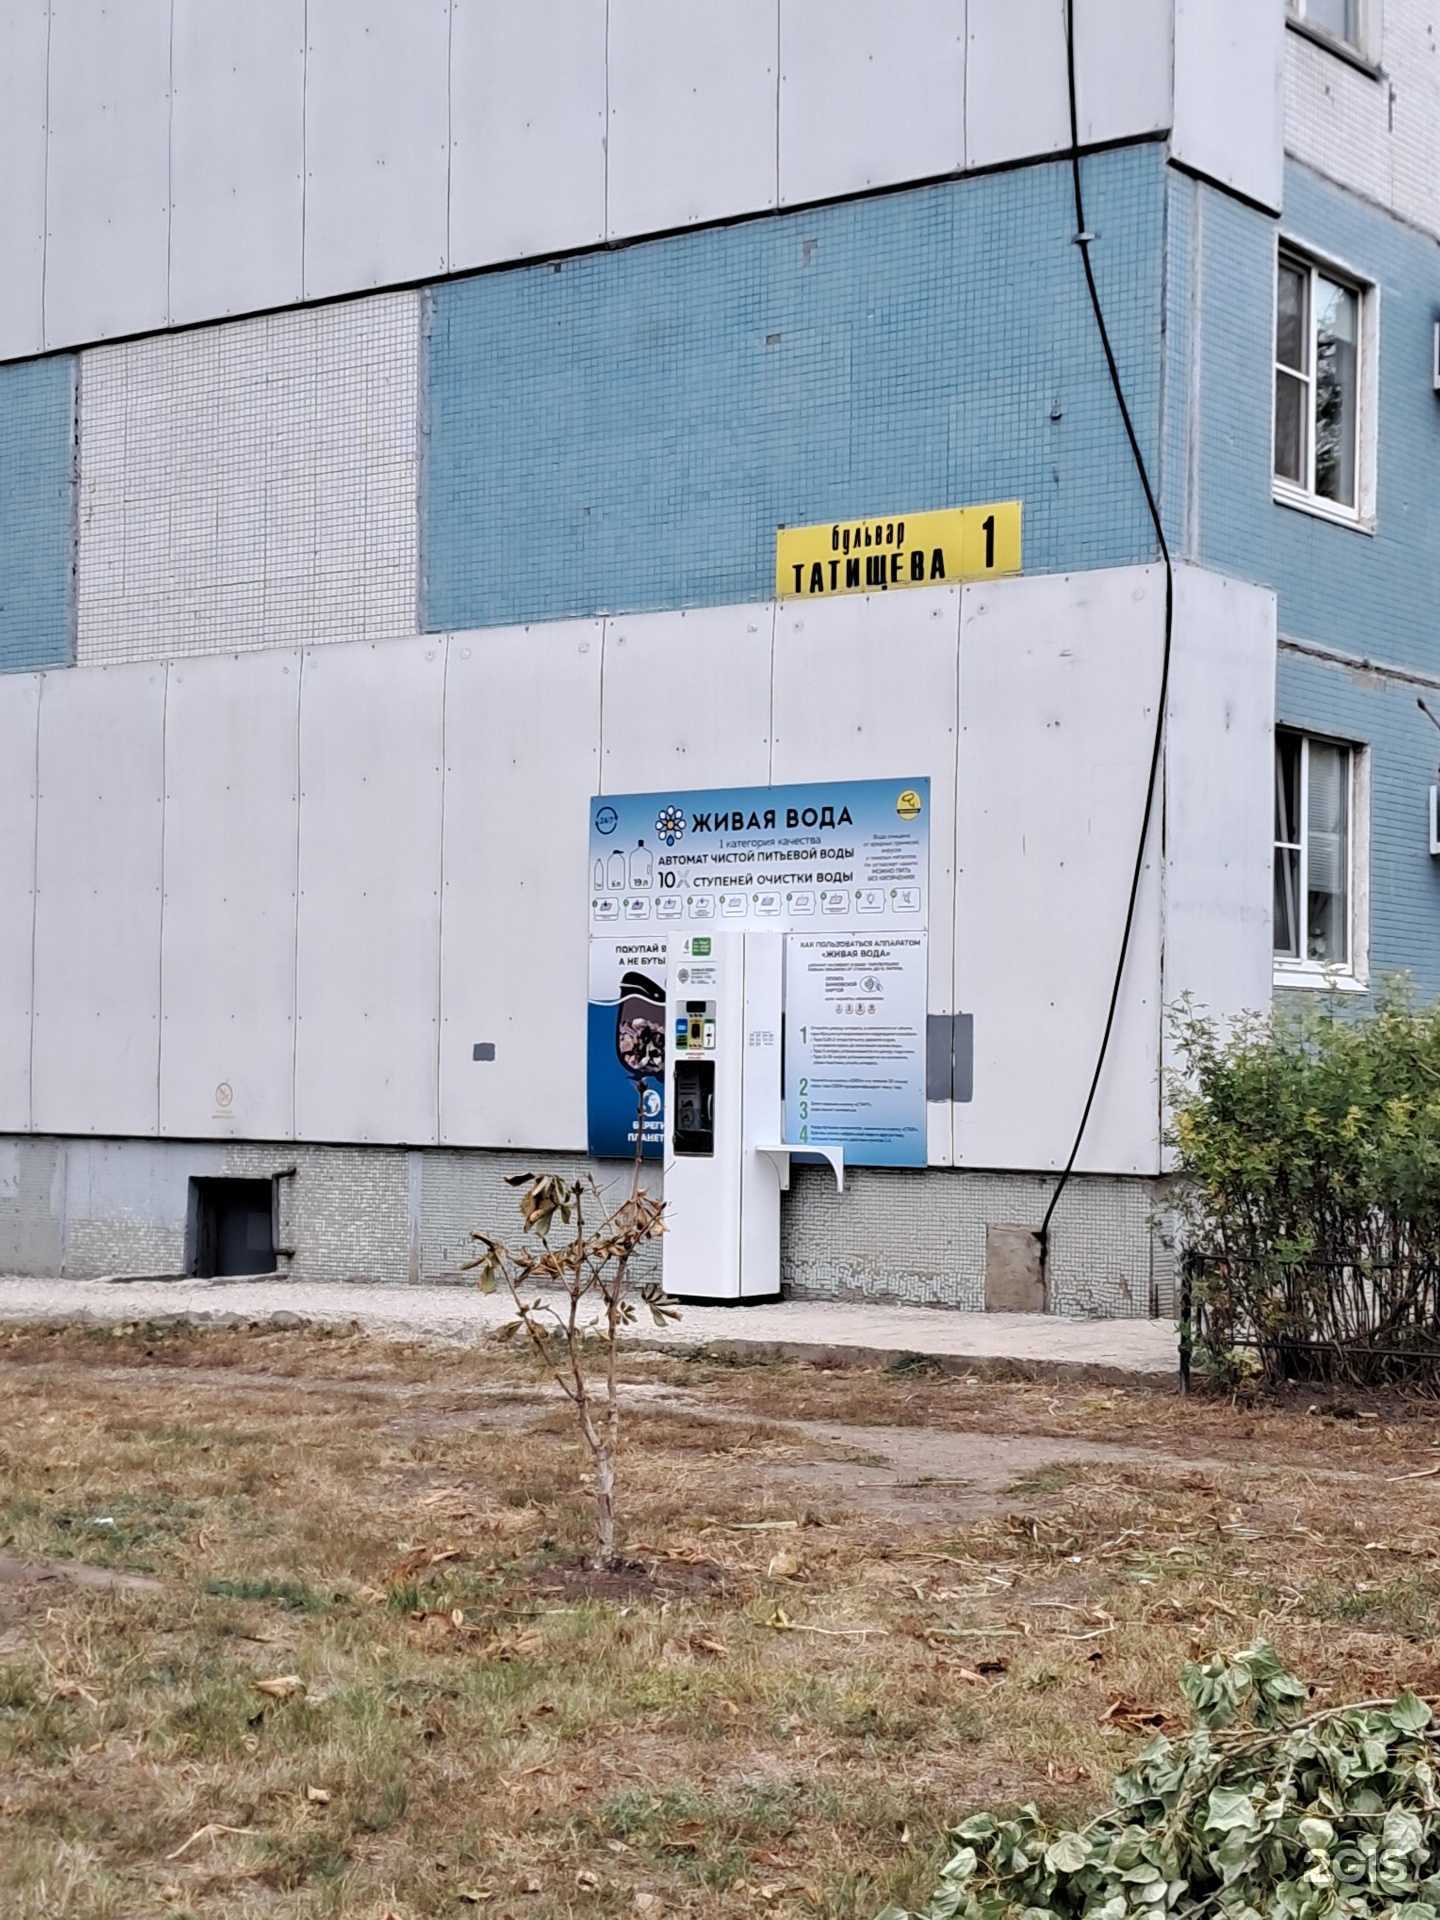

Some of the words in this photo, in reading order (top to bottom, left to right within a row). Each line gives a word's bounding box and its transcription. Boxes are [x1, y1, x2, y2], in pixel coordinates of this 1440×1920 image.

[831, 521, 905, 555] бульвар
[792, 548, 946, 593] ТАТИЩЕВА
[982, 515, 995, 568] 1
[691, 810, 776, 833] ЖИВАЯ
[786, 805, 853, 830] ВОДА
[725, 838, 775, 850] категория
[777, 835, 822, 847] качества
[658, 854, 708, 866] АВТОМАТ
[710, 849, 755, 864] ЧИСТОЙ
[757, 847, 817, 862] ПИТЬЕВОЙ
[820, 847, 855, 859] ВОДЫ
[693, 872, 753, 888] СТУПЕНЕЙ
[756, 872, 813, 887] ОЧИСТКИ
[816, 871, 854, 884] ВОДЫ
[615, 943, 659, 955] ПОКУПАЙ
[815, 940, 873, 948] ПОЛЬЗОВАТЬСЯ
[874, 939, 921, 947] АППАРАТОМ
[619, 958, 625, 966] А
[627, 957, 639, 966] НЕ
[799, 1025, 807, 1045] 1
[799, 1077, 808, 1097] 2
[799, 1100, 808, 1120] 3
[799, 1124, 808, 1144] 4
